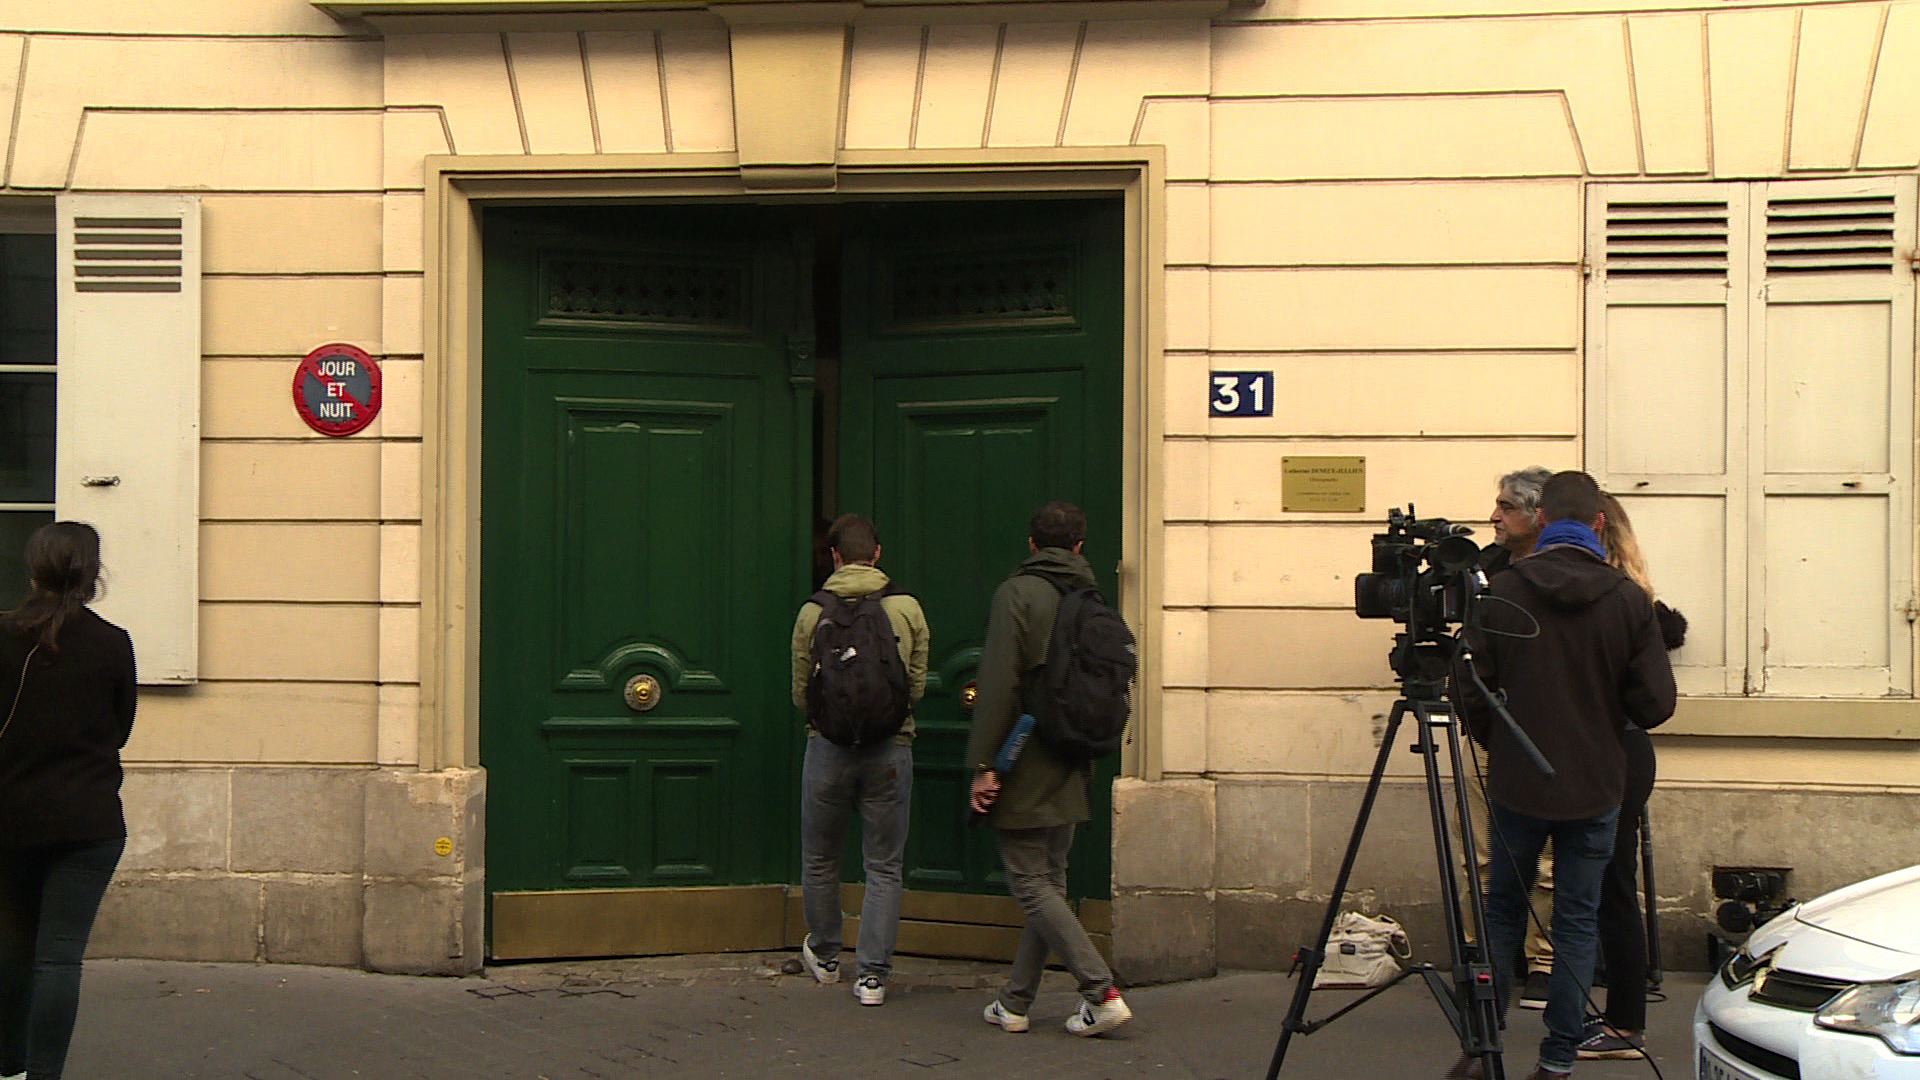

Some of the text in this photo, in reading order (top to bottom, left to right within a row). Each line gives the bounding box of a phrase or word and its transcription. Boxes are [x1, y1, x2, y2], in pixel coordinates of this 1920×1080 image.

[318, 361, 356, 376] JOUR
[327, 382, 346, 397] ET
[1213, 376, 1264, 412] 31
[319, 402, 354, 418] NUIT
